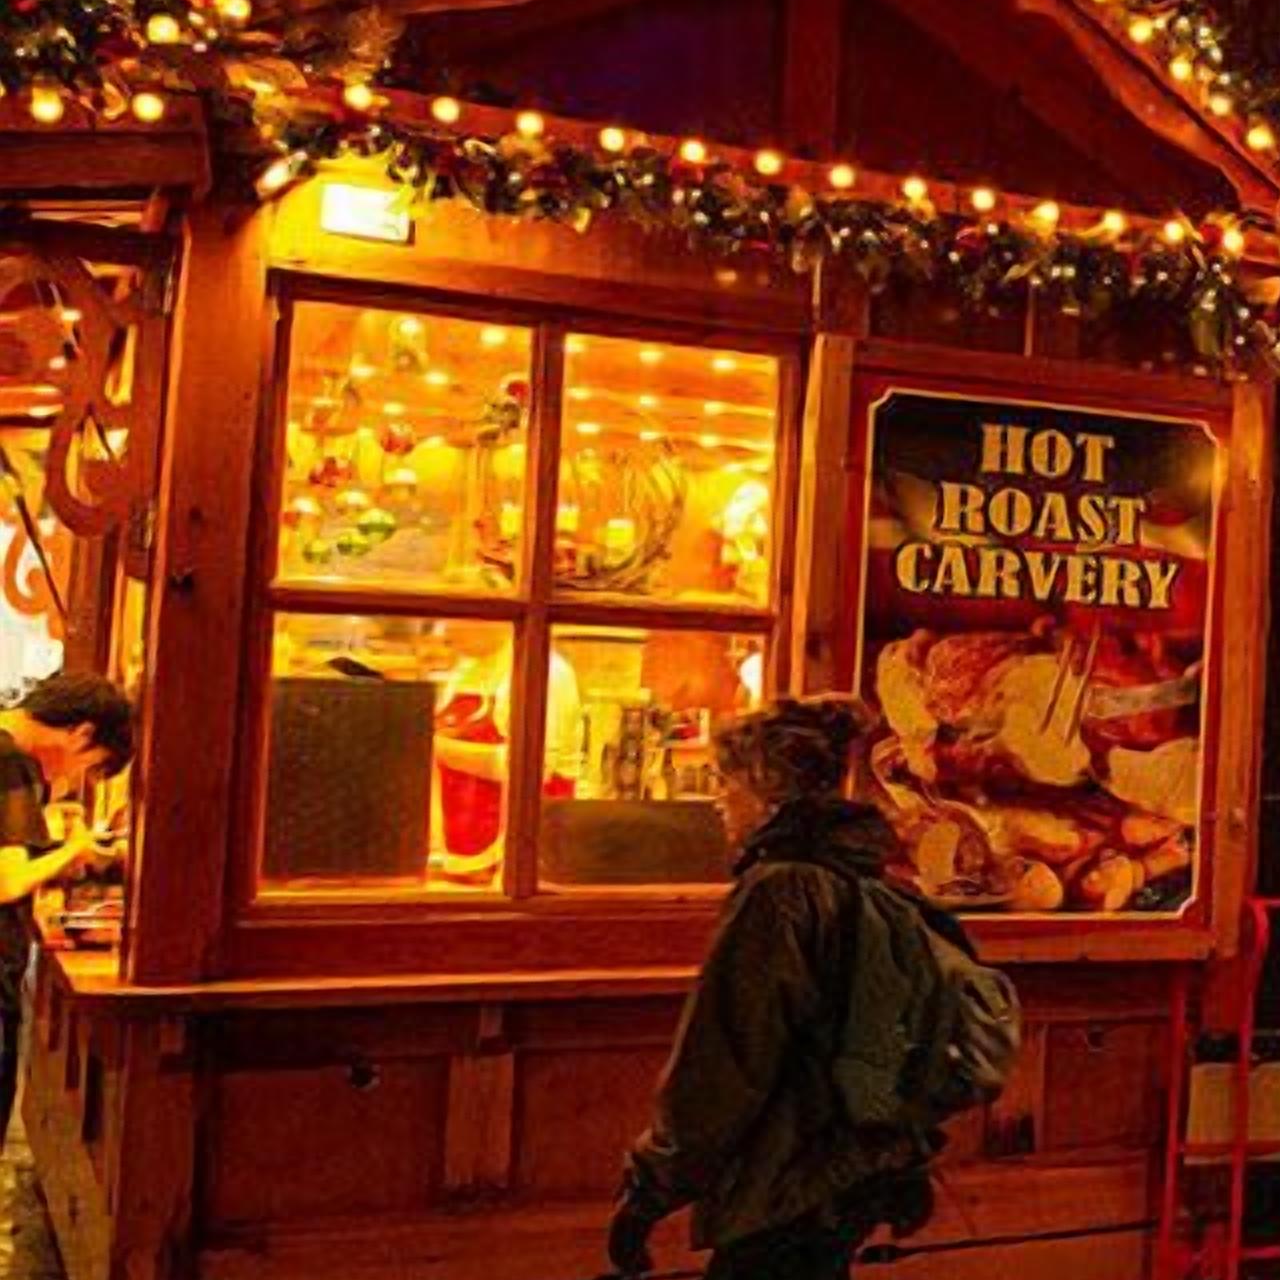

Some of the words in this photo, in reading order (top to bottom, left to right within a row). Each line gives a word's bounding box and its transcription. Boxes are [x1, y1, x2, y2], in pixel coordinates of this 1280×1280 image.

[982, 423, 1114, 482] HOT
[940, 483, 1146, 549] ROAST
[895, 543, 1179, 609] CARVERY
